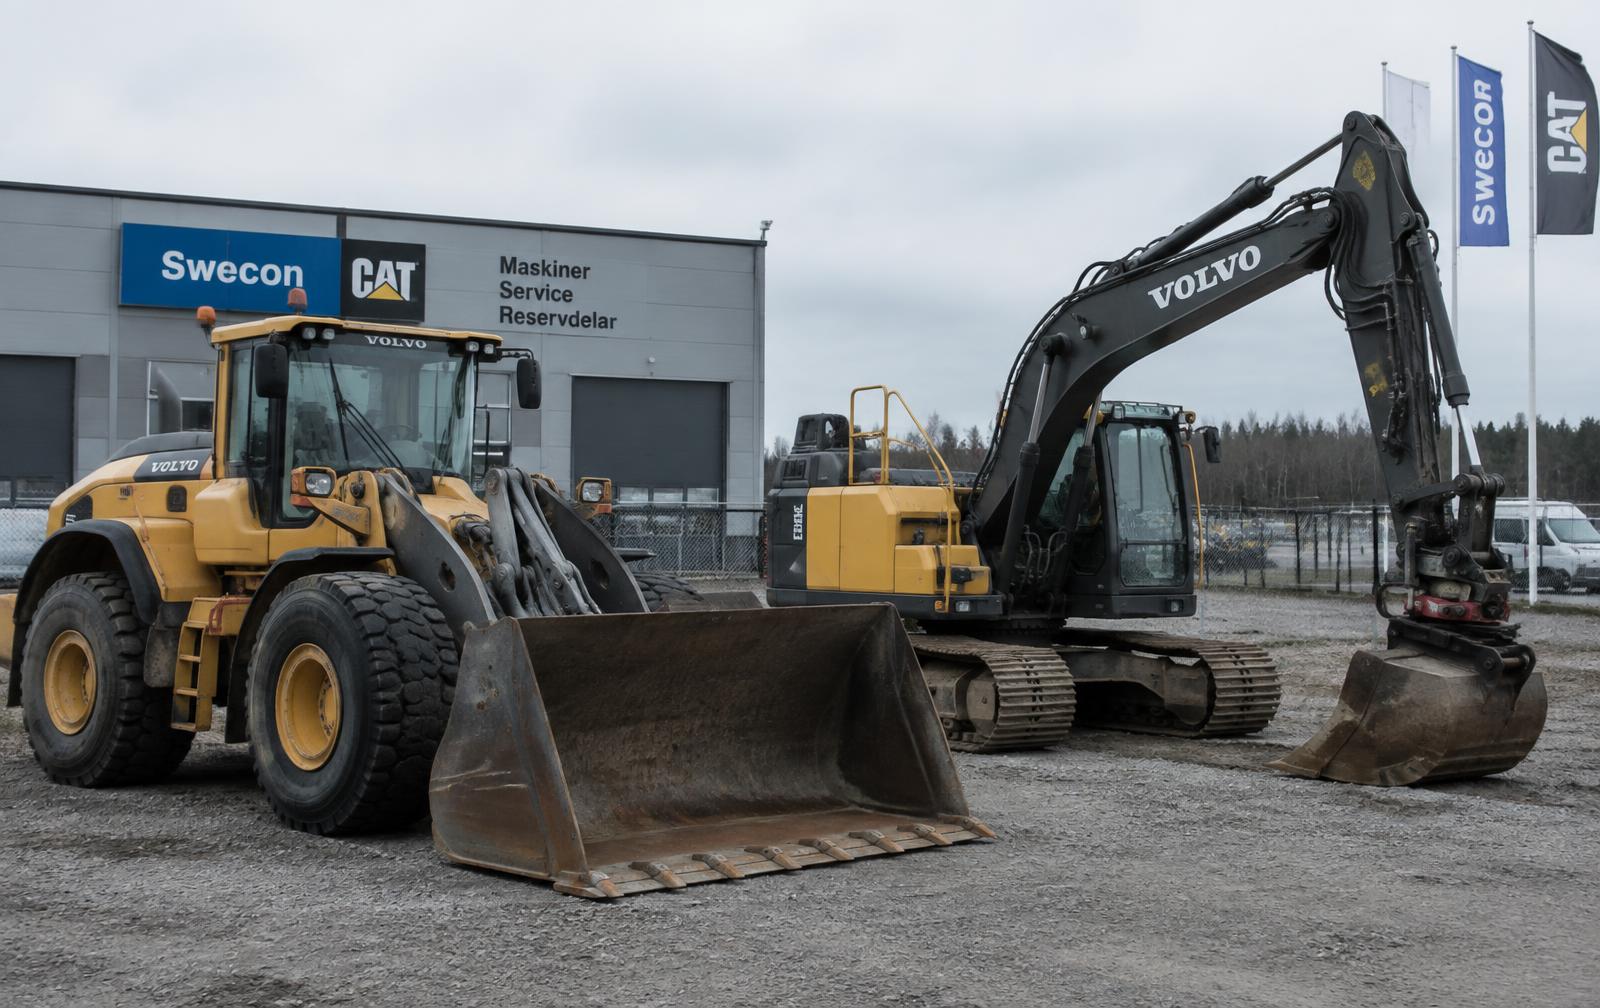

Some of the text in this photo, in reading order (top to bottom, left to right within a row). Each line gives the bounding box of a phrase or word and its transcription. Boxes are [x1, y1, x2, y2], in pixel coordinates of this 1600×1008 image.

[1547, 91, 1588, 174] CAT
[162, 250, 304, 287] Swecon
[352, 257, 416, 302] CAT
[500, 255, 591, 280] Maskiner
[1147, 245, 1261, 309] VOLVO
[500, 280, 573, 303] Service
[500, 305, 617, 330] Reservdelar
[364, 335, 427, 349] VOLVO
[151, 459, 199, 473] VOLVO
